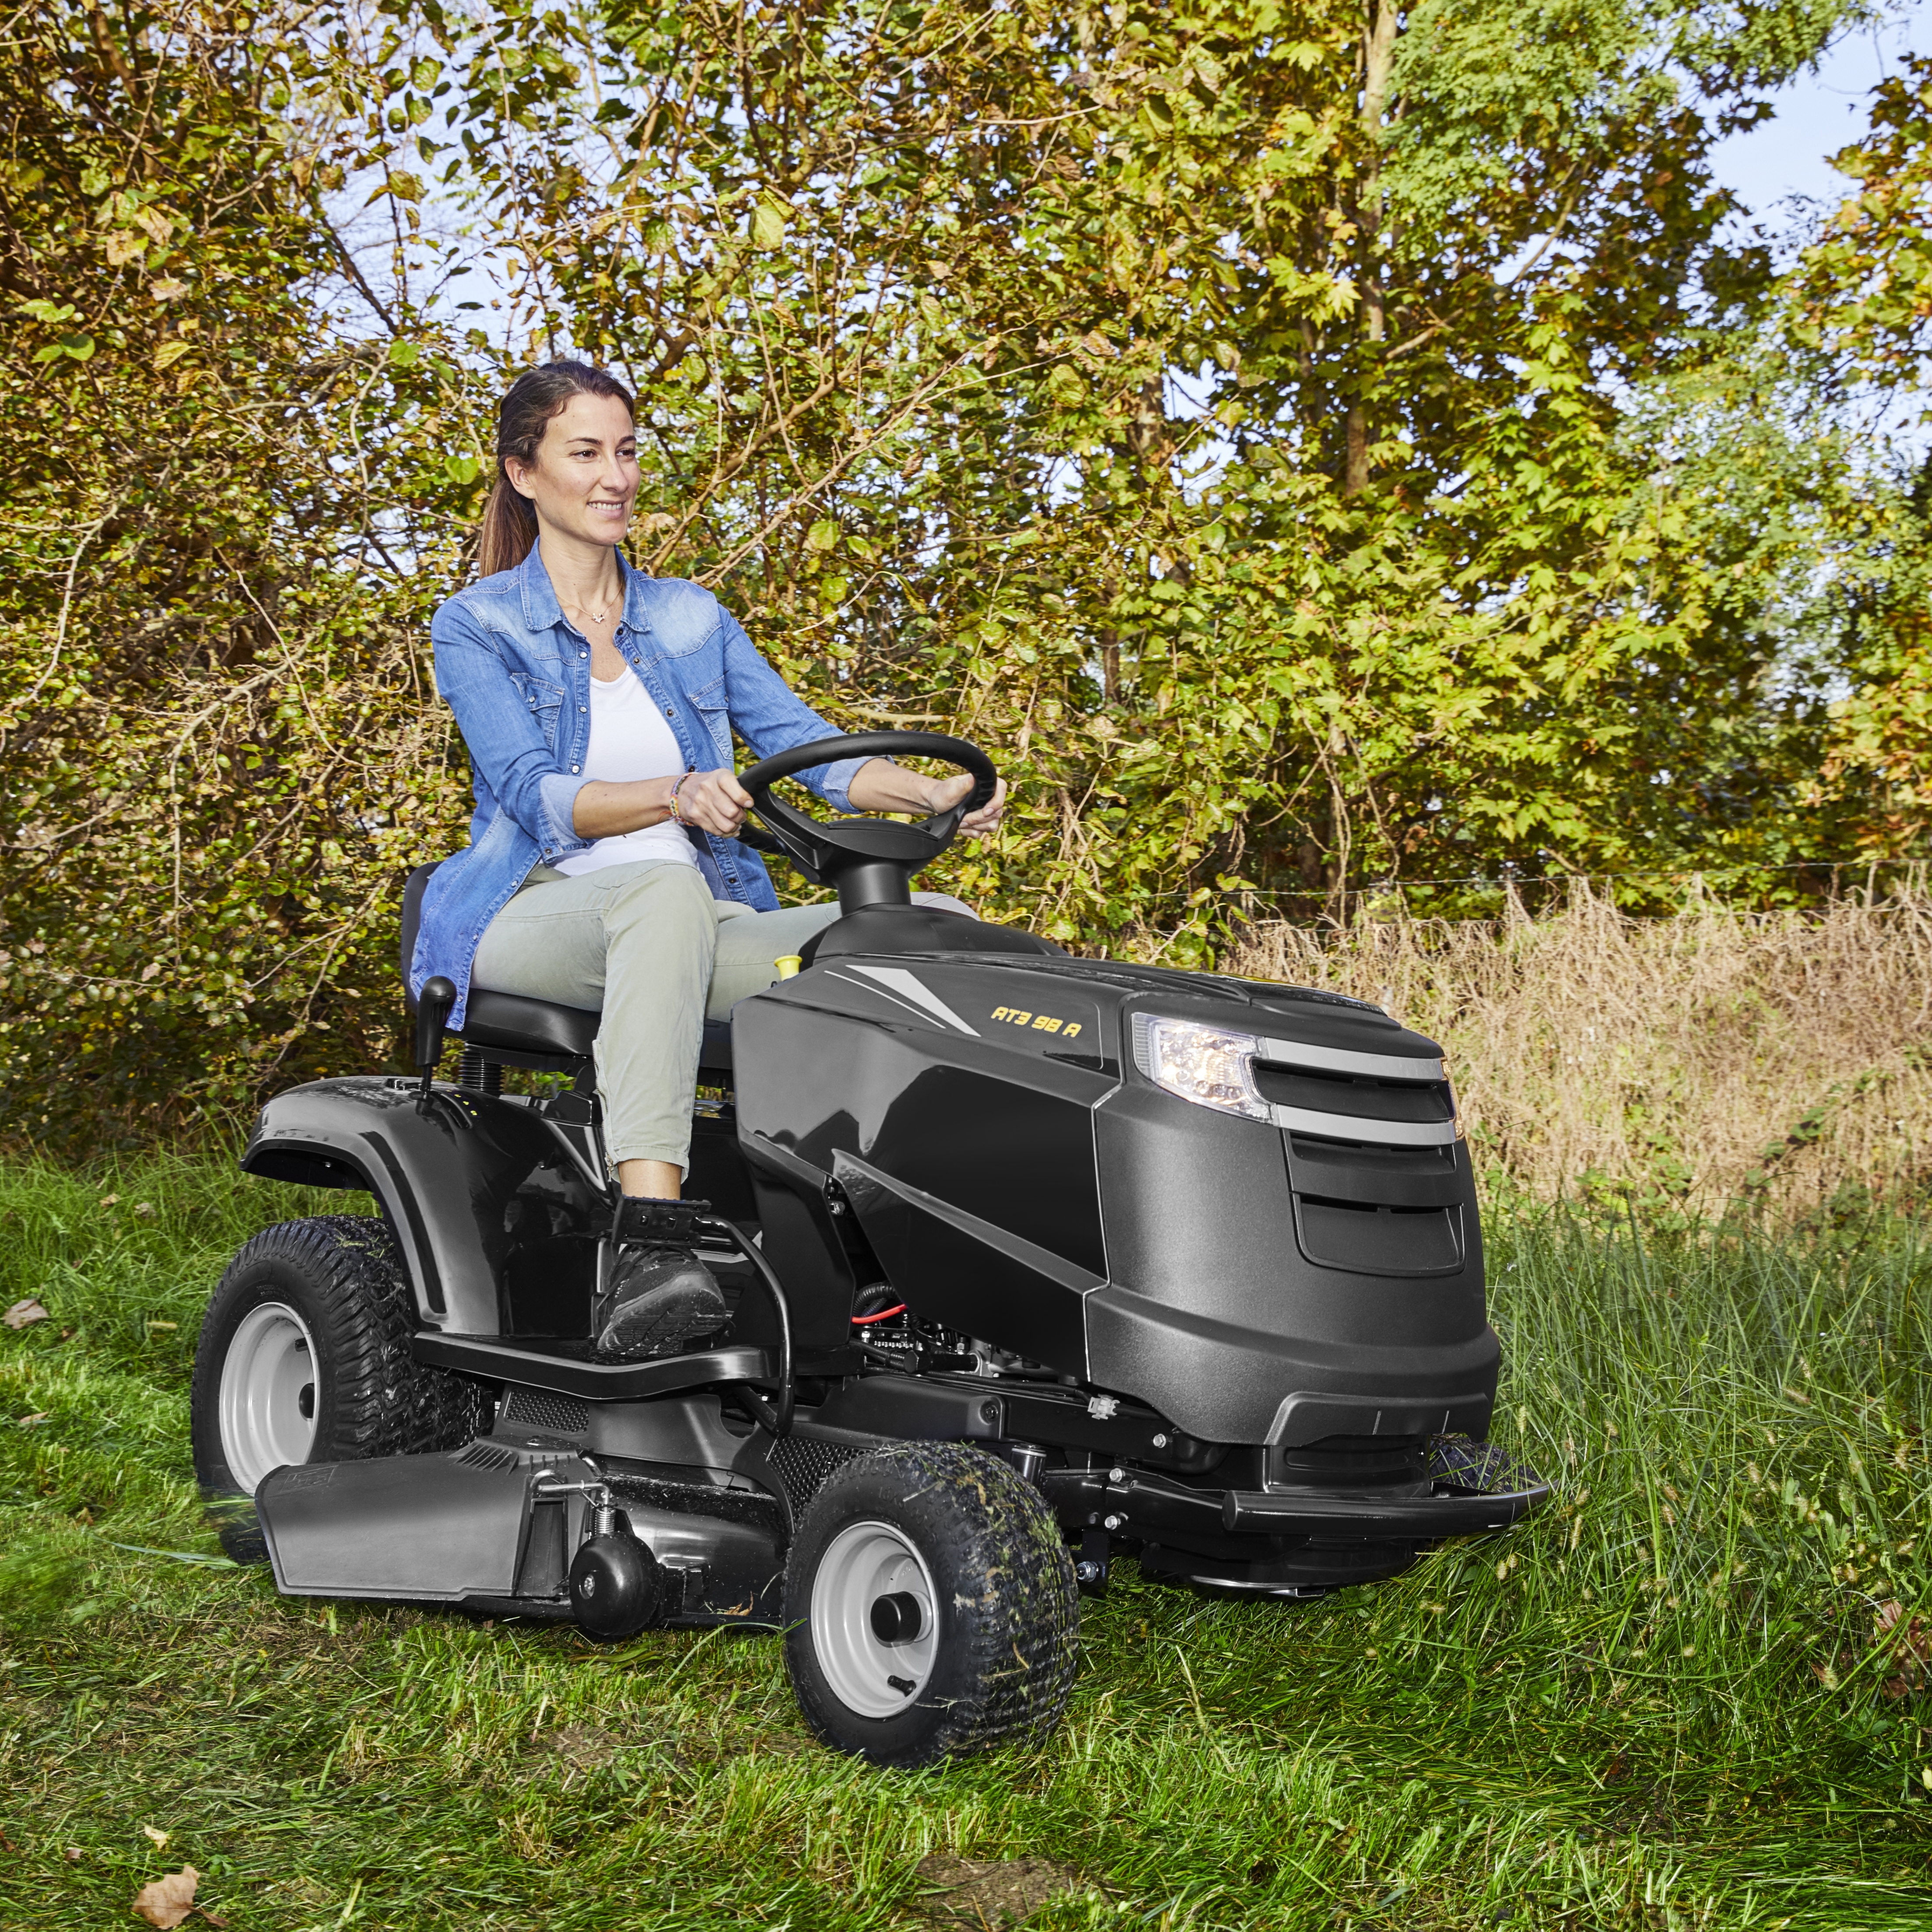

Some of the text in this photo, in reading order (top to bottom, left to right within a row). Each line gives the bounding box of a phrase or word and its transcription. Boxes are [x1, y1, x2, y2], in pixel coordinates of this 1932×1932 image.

[991, 1007, 1082, 1037] AT3 98 A
